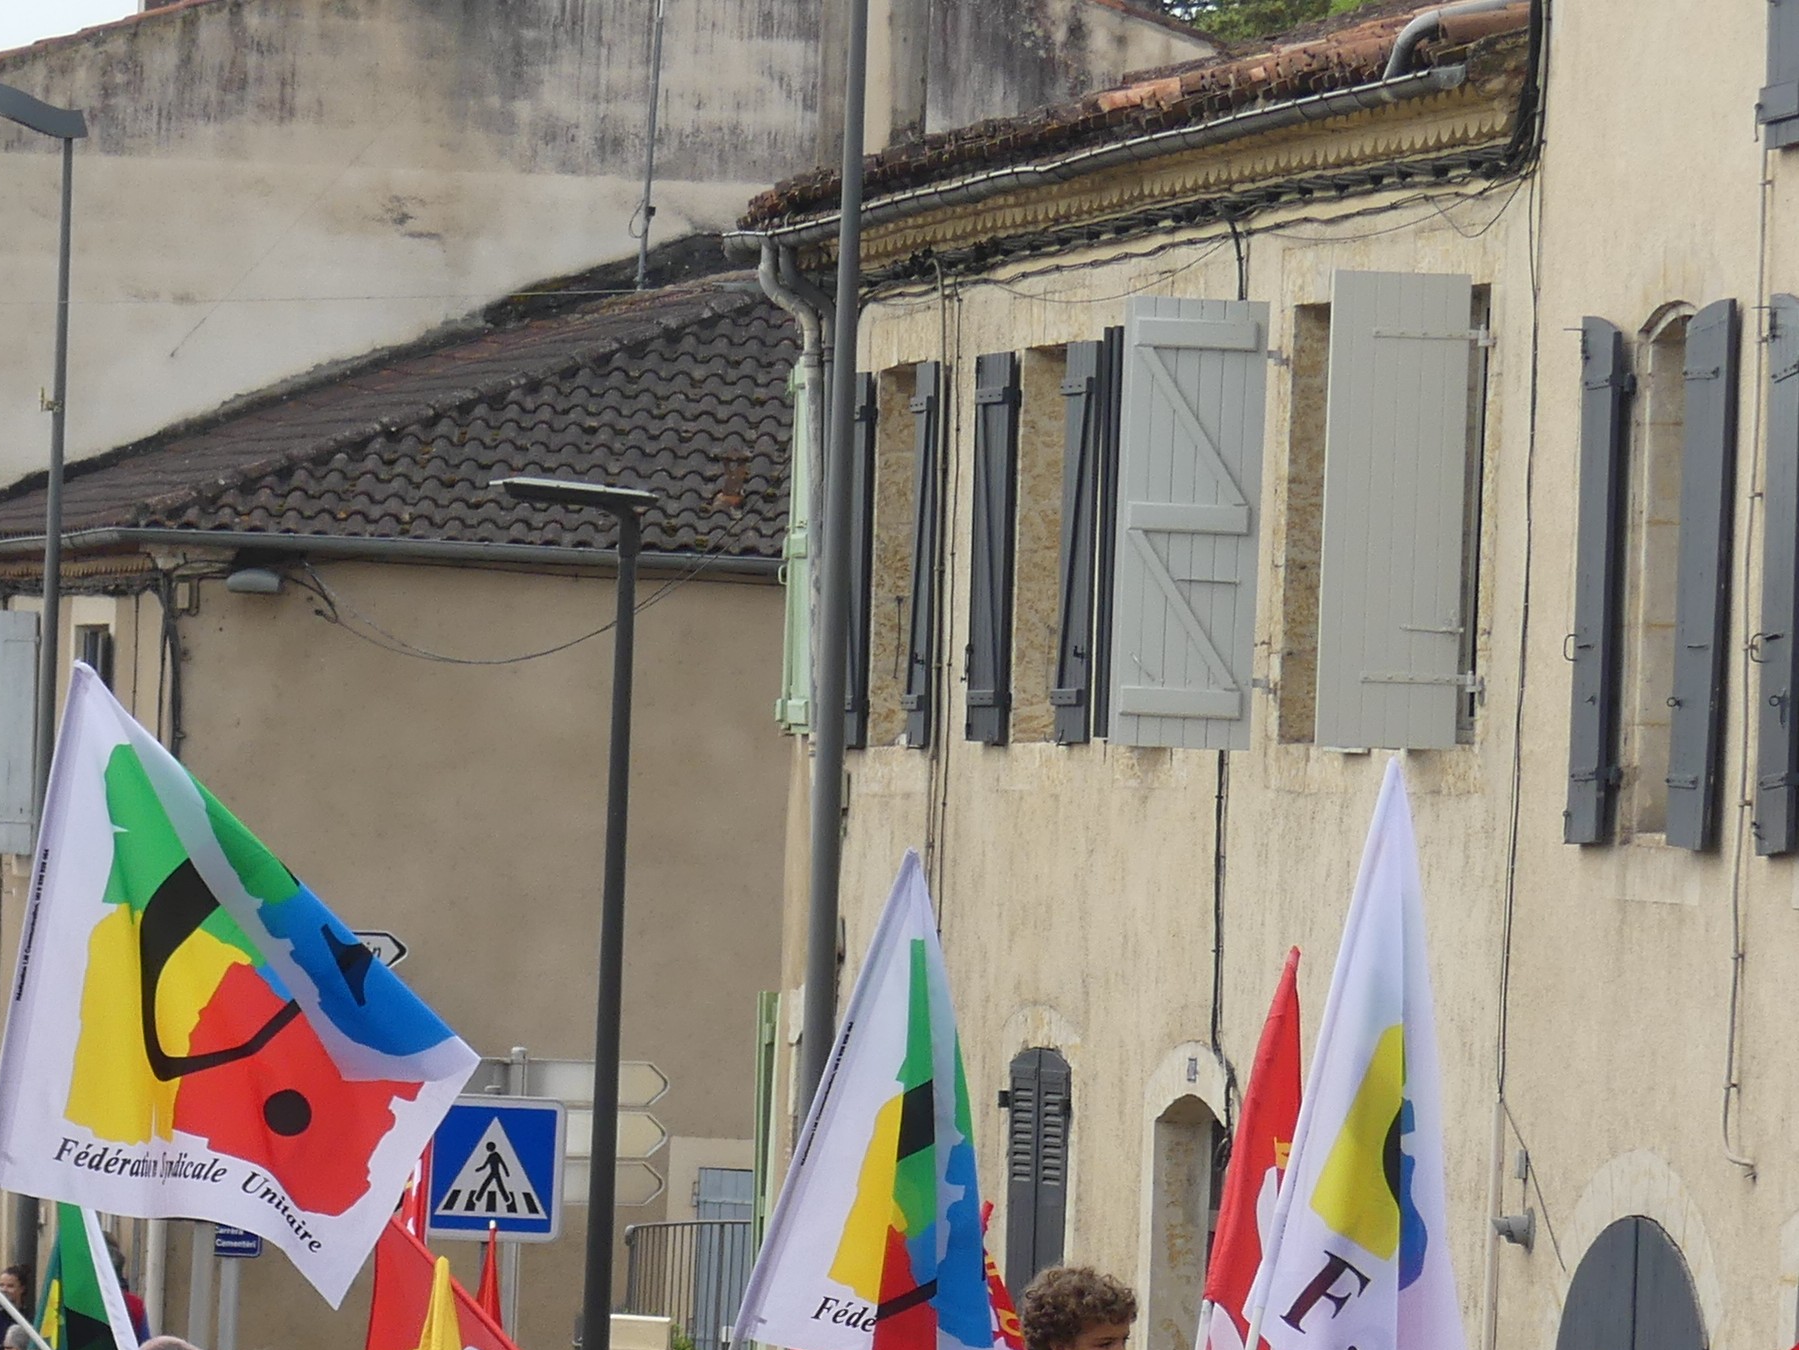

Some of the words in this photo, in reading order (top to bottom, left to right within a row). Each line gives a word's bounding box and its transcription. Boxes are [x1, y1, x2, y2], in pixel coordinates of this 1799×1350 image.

[52, 1137, 158, 1179] Fédération
[159, 1151, 229, 1185] Syndicale
[240, 1170, 323, 1254] Unitaire
